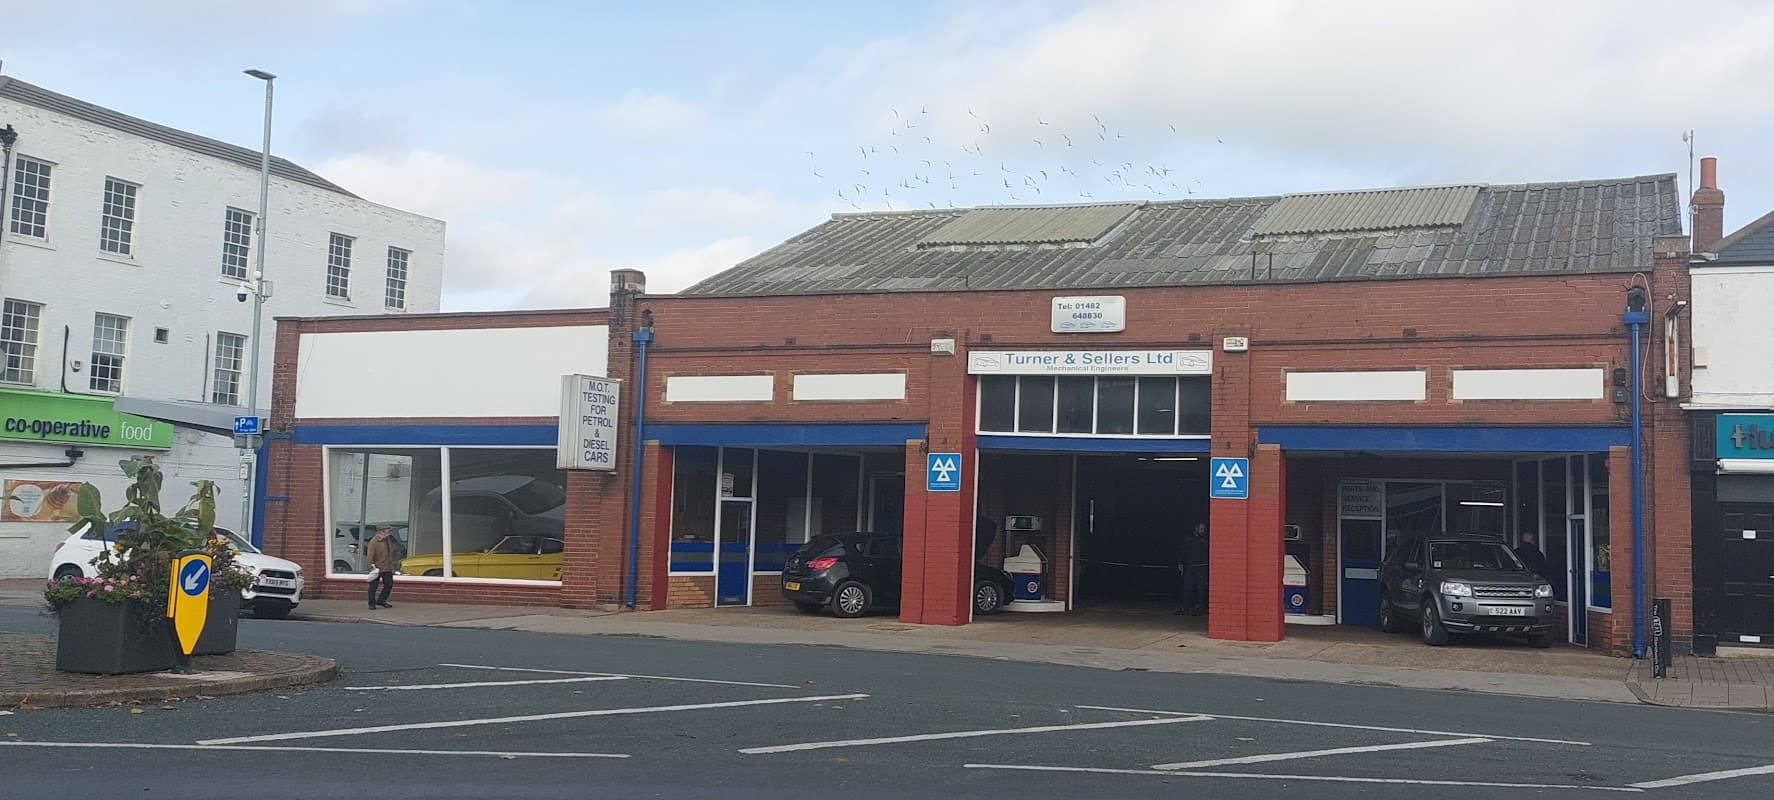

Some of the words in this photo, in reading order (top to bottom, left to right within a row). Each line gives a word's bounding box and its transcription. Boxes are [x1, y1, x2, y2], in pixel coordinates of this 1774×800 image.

[1075, 302, 1101, 310] 01482
[1005, 353, 1059, 365] Turner
[1065, 352, 1076, 365] &
[1082, 352, 1141, 365] Sellers
[1147, 352, 1173, 364] Ltd
[588, 380, 610, 393] M.O.T.
[582, 392, 616, 405] TESTING
[590, 404, 607, 415] FOR
[582, 415, 613, 428] PETROL
[5, 417, 110, 439] co-operative
[121, 421, 153, 441] food
[594, 429, 600, 438] &
[583, 438, 610, 451] DIESEL
[584, 450, 609, 464] CARS
